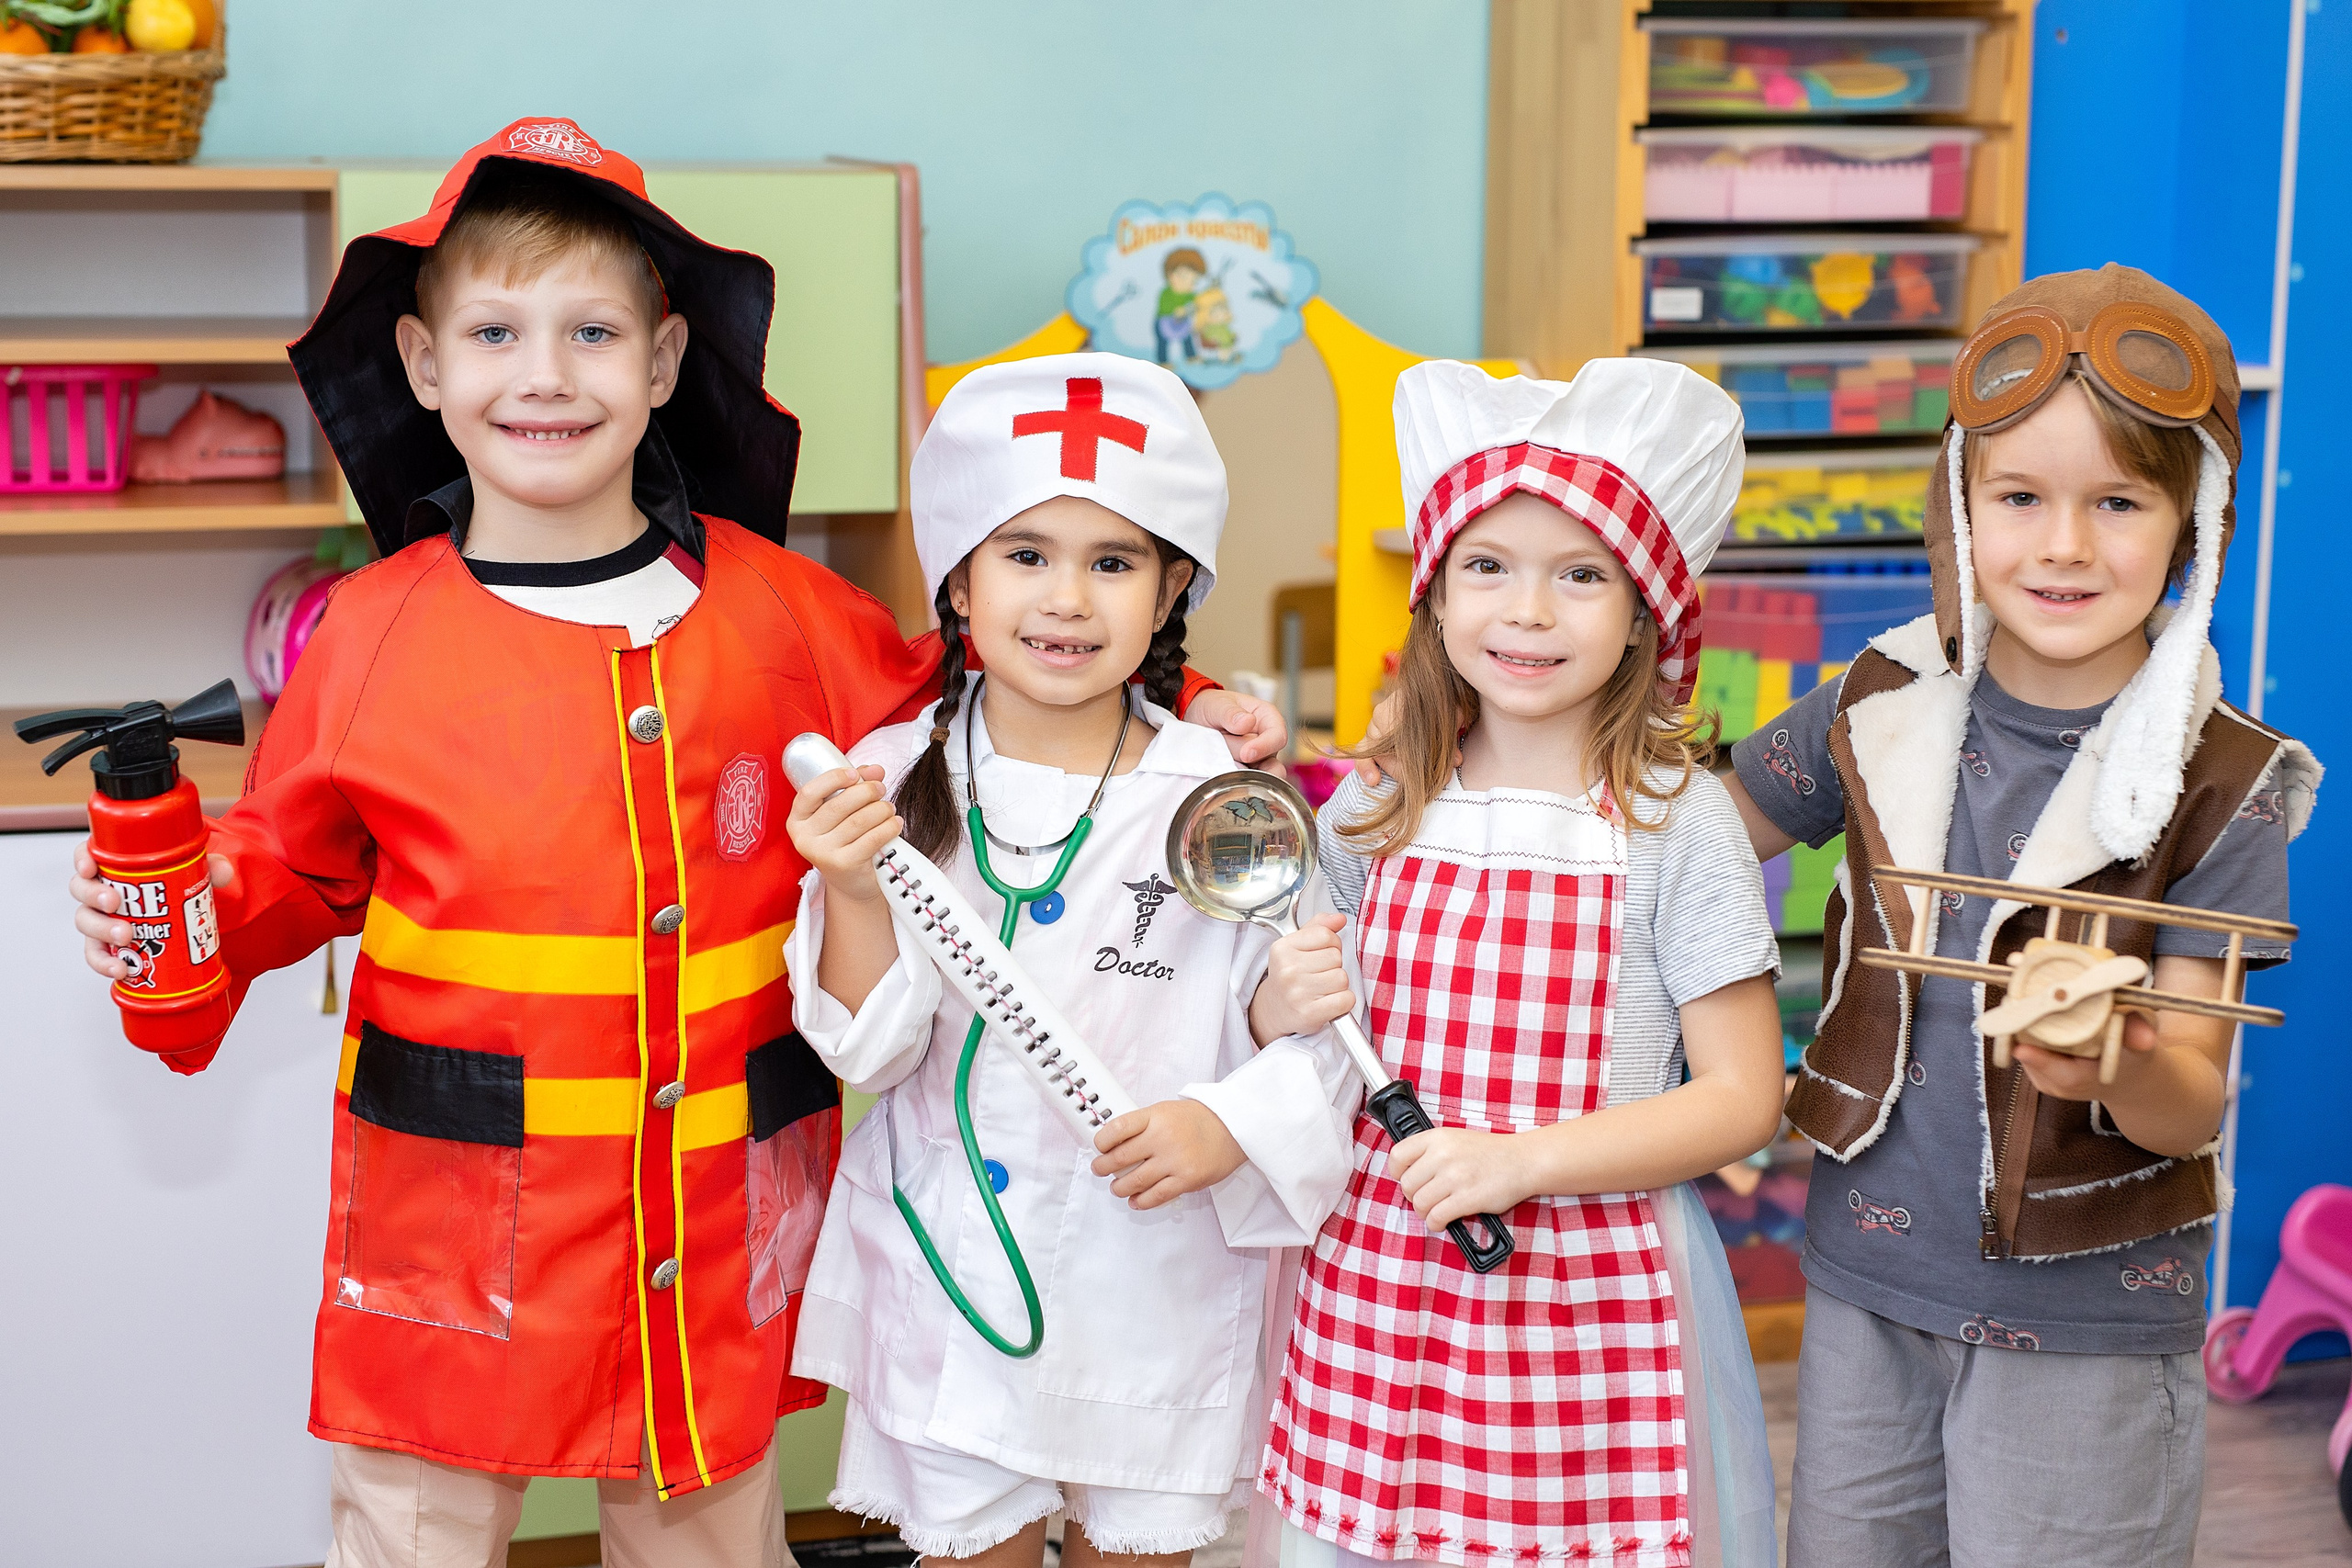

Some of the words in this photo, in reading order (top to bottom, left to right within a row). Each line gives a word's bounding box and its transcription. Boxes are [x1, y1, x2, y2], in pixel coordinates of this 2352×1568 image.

[734, 766, 748, 777] FIRE
[133, 923, 171, 940] isher
[1094, 946, 1175, 980] Doctor
